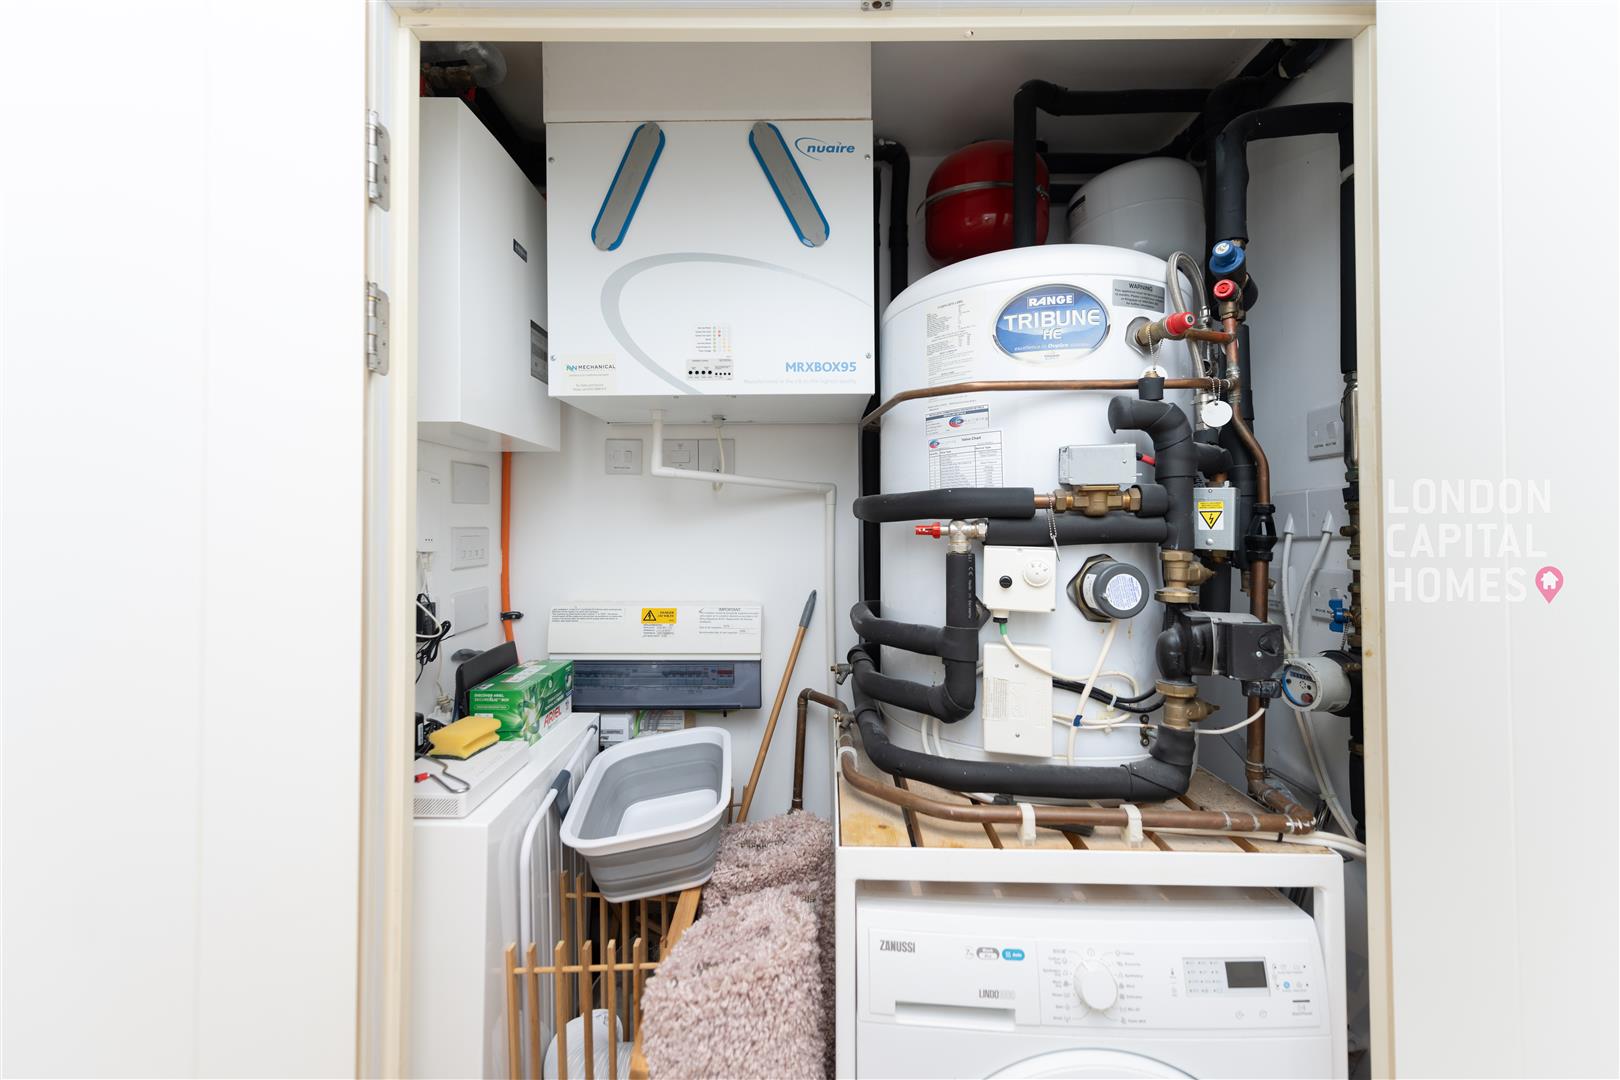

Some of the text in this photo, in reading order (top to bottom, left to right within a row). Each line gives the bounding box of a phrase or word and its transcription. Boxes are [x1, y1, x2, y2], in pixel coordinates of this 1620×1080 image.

[806, 143, 856, 153] nuaire
[1028, 295, 1073, 306] RANGE
[1004, 310, 1100, 331] TRIBUNE
[1042, 329, 1062, 340] HE
[786, 361, 857, 373] MRXBOX95
[544, 706, 561, 728] ARIEL
[880, 940, 916, 953] ZANUSSI
